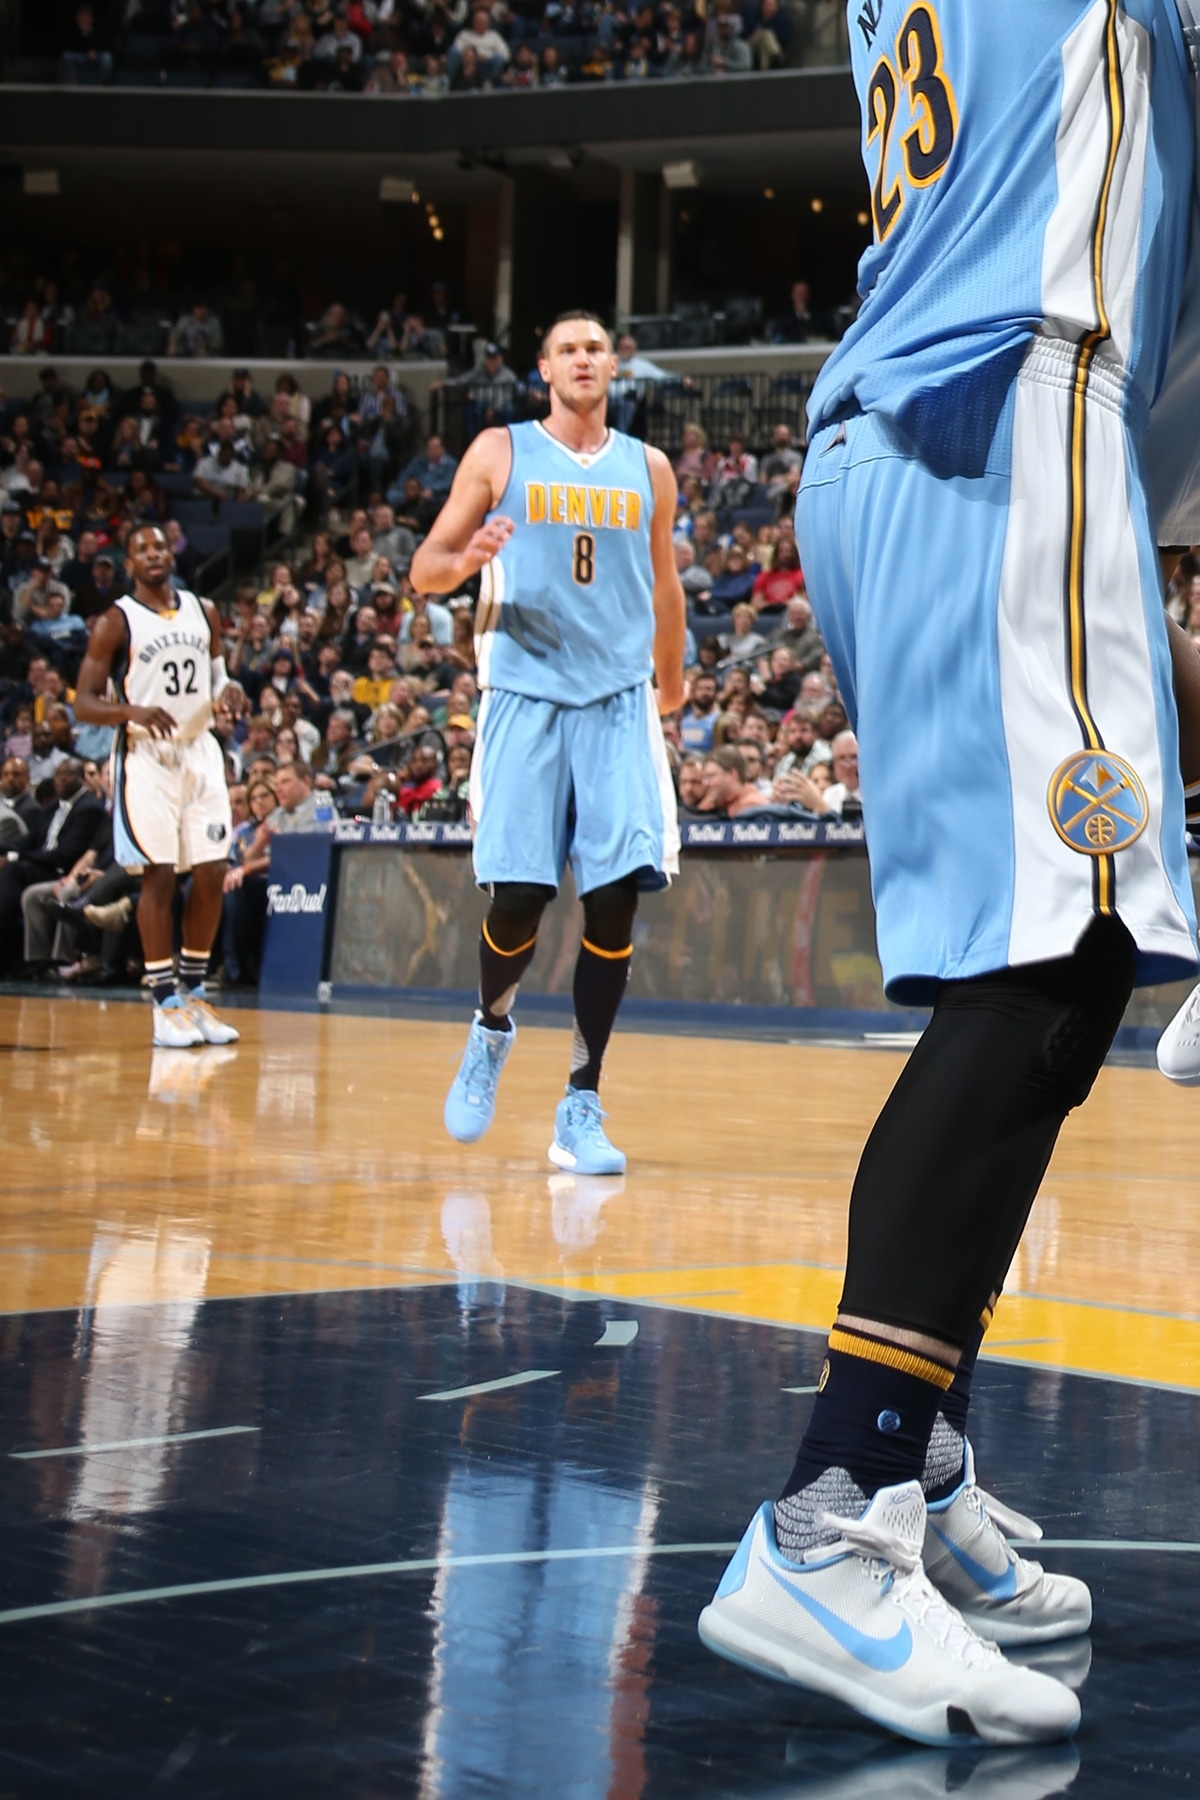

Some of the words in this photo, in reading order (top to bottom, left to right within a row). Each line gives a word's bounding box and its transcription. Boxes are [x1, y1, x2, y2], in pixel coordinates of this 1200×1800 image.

[525, 482, 640, 532] DENVER
[573, 531, 594, 586] 8
[163, 658, 198, 696] 32
[688, 824, 726, 842] FanDuel
[732, 823, 771, 842] FanDuel
[778, 823, 817, 842] FanDuel
[266, 883, 327, 916] FanDuel
